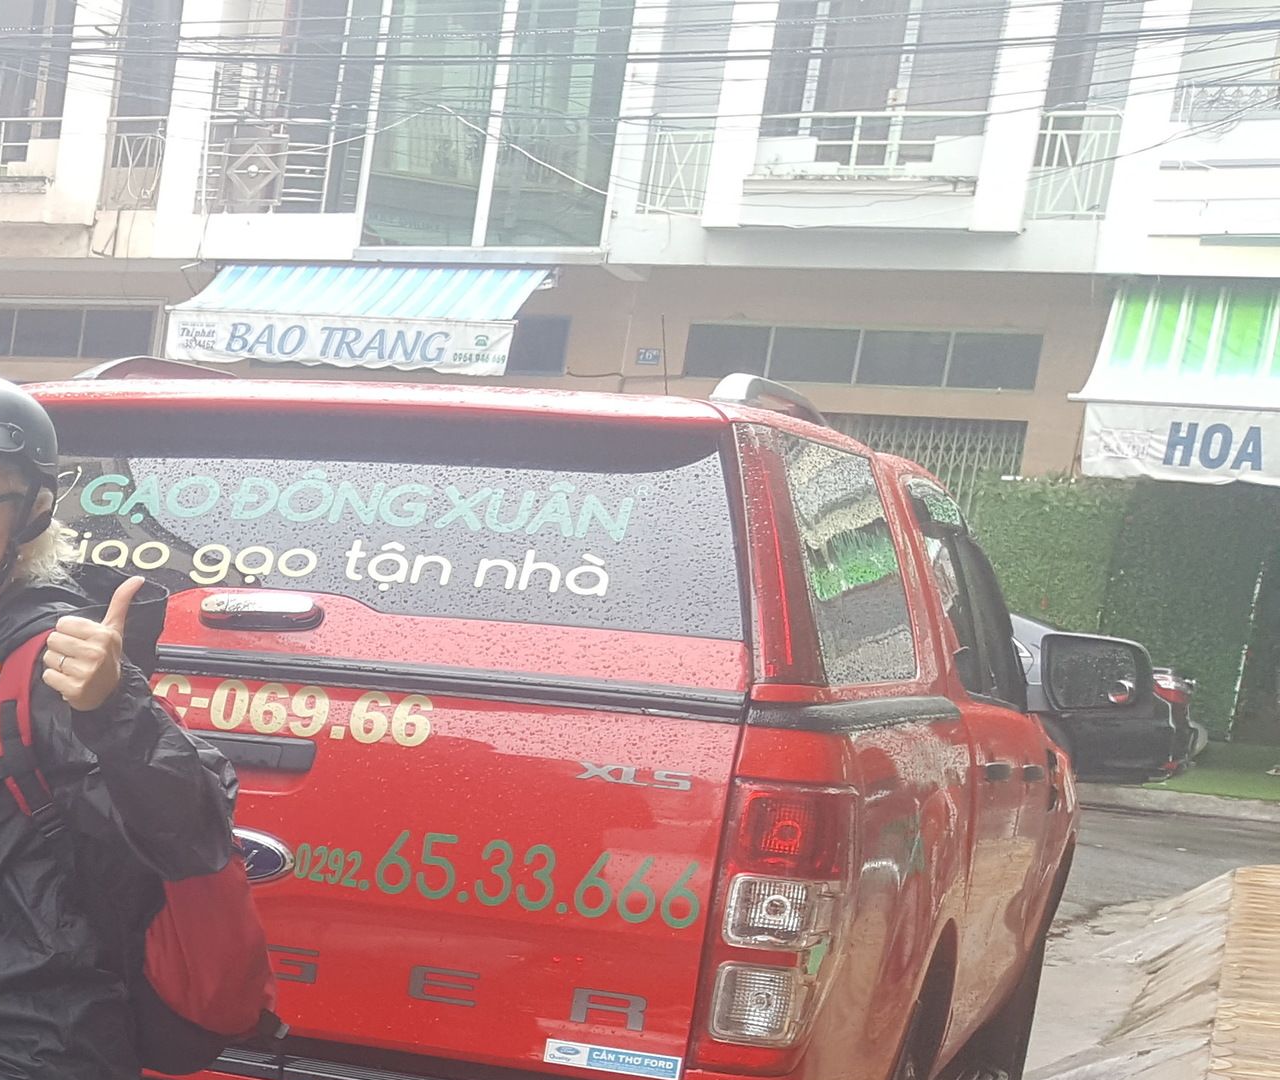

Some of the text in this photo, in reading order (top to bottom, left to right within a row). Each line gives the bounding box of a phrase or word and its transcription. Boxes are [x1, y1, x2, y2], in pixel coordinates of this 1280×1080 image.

[225, 322, 451, 363] BAO TRANG
[1162, 420, 1263, 472] HOA
[80, 468, 636, 542] GẠO ĐÔNG XUÂN
[189, 543, 318, 585] gạo
[344, 538, 453, 591] tận
[473, 549, 610, 597] nhà
[575, 760, 693, 792] XLS
[643, 1058, 674, 1070] FORD
